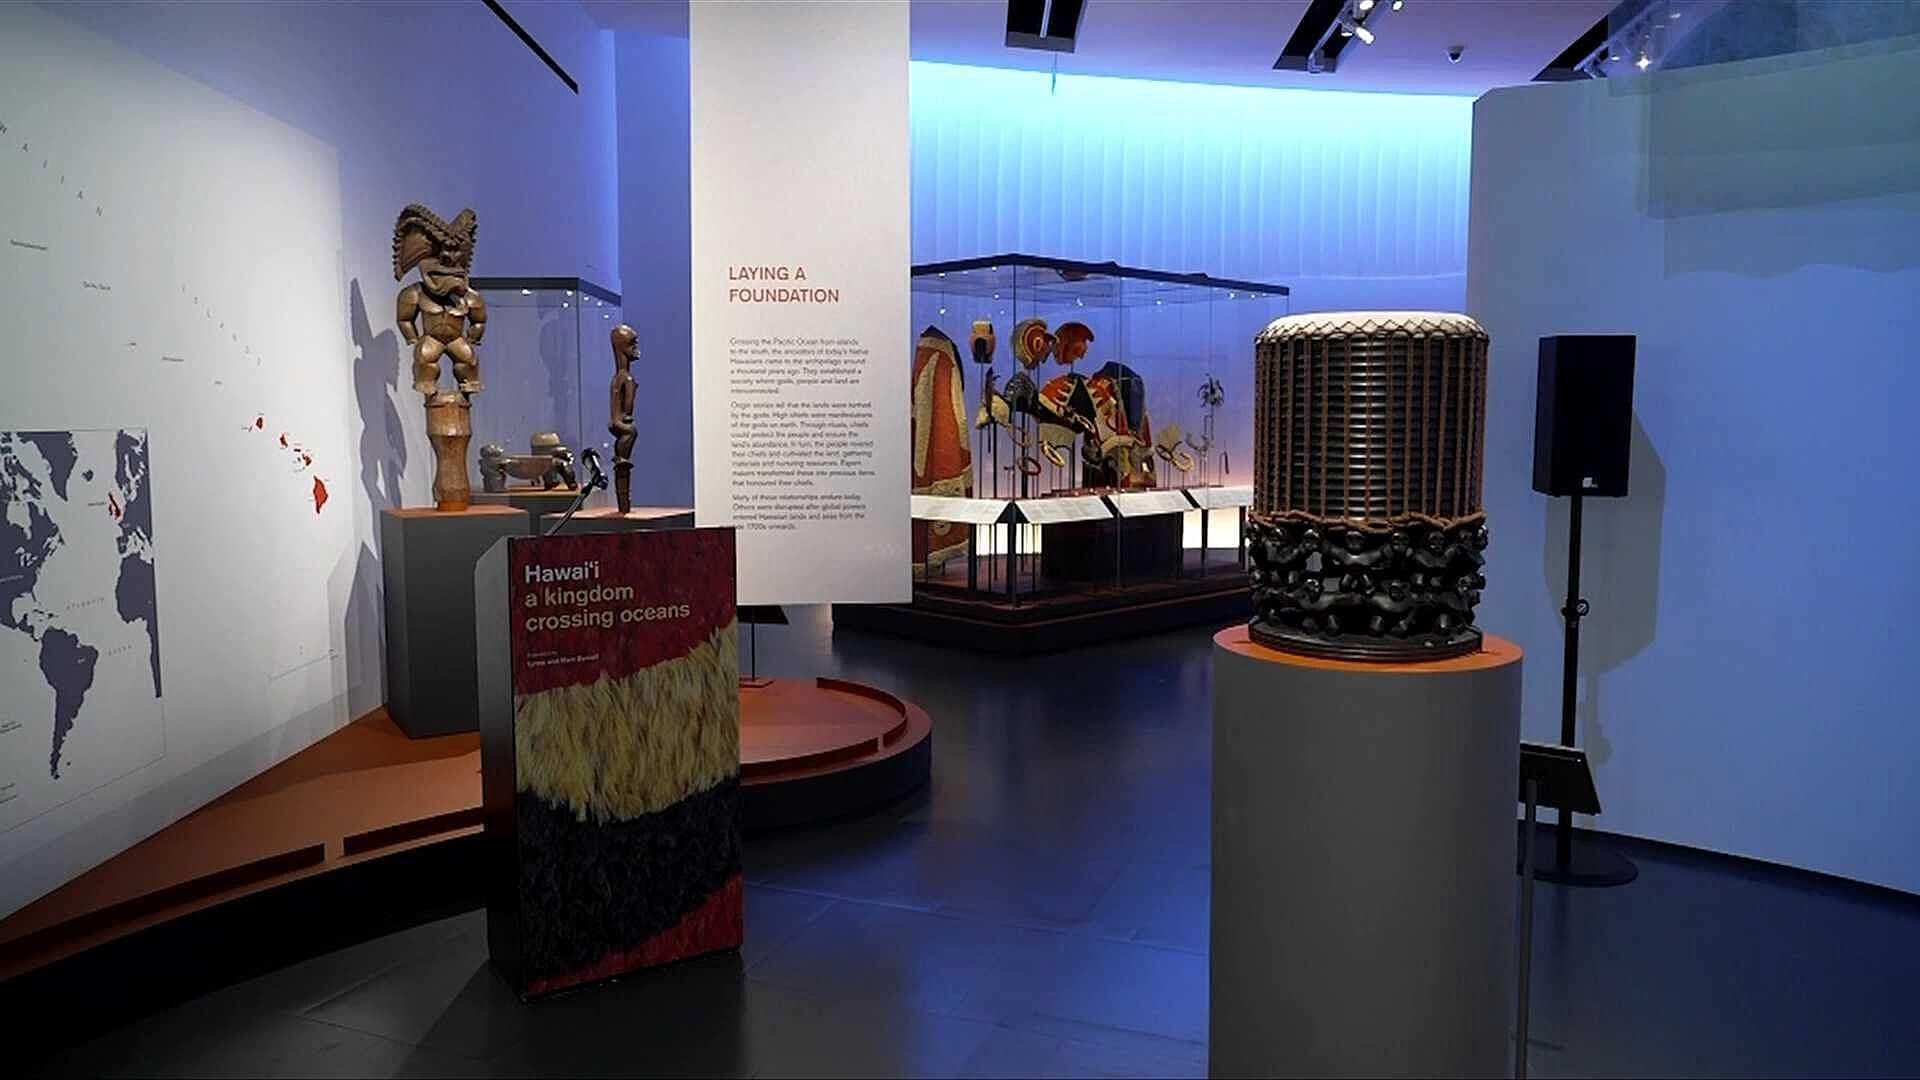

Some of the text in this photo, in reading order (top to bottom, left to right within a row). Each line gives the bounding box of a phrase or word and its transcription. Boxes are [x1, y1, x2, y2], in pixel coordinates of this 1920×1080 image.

[729, 267, 806, 281] LAYING A
[729, 288, 839, 303] FOUNDATION
[525, 584, 634, 609] a kingdom
[525, 604, 691, 633] crossing oceans
